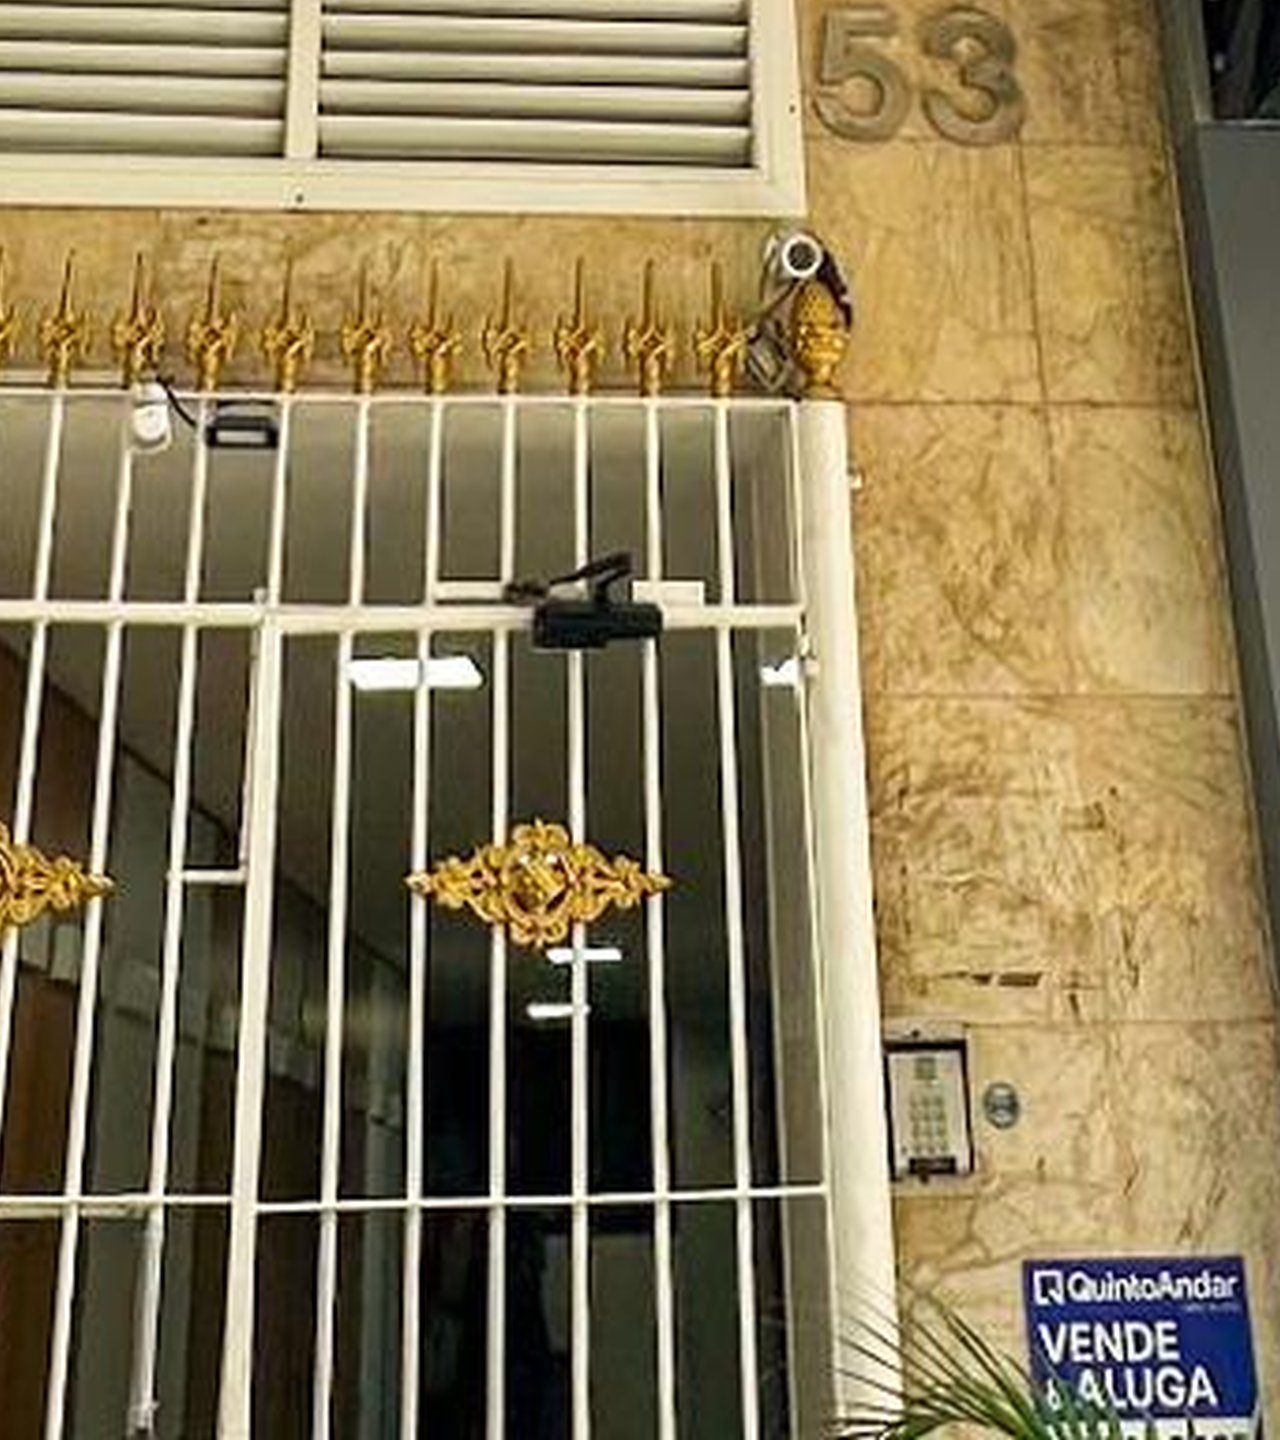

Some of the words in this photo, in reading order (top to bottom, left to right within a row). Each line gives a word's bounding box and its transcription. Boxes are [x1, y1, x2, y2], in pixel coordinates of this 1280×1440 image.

[811, 2, 1024, 148] 53
[1067, 1268, 1238, 1303] QuintoAndar
[1037, 1321, 1181, 1364] VENDE
[1077, 1365, 1218, 1409] ALUGA
